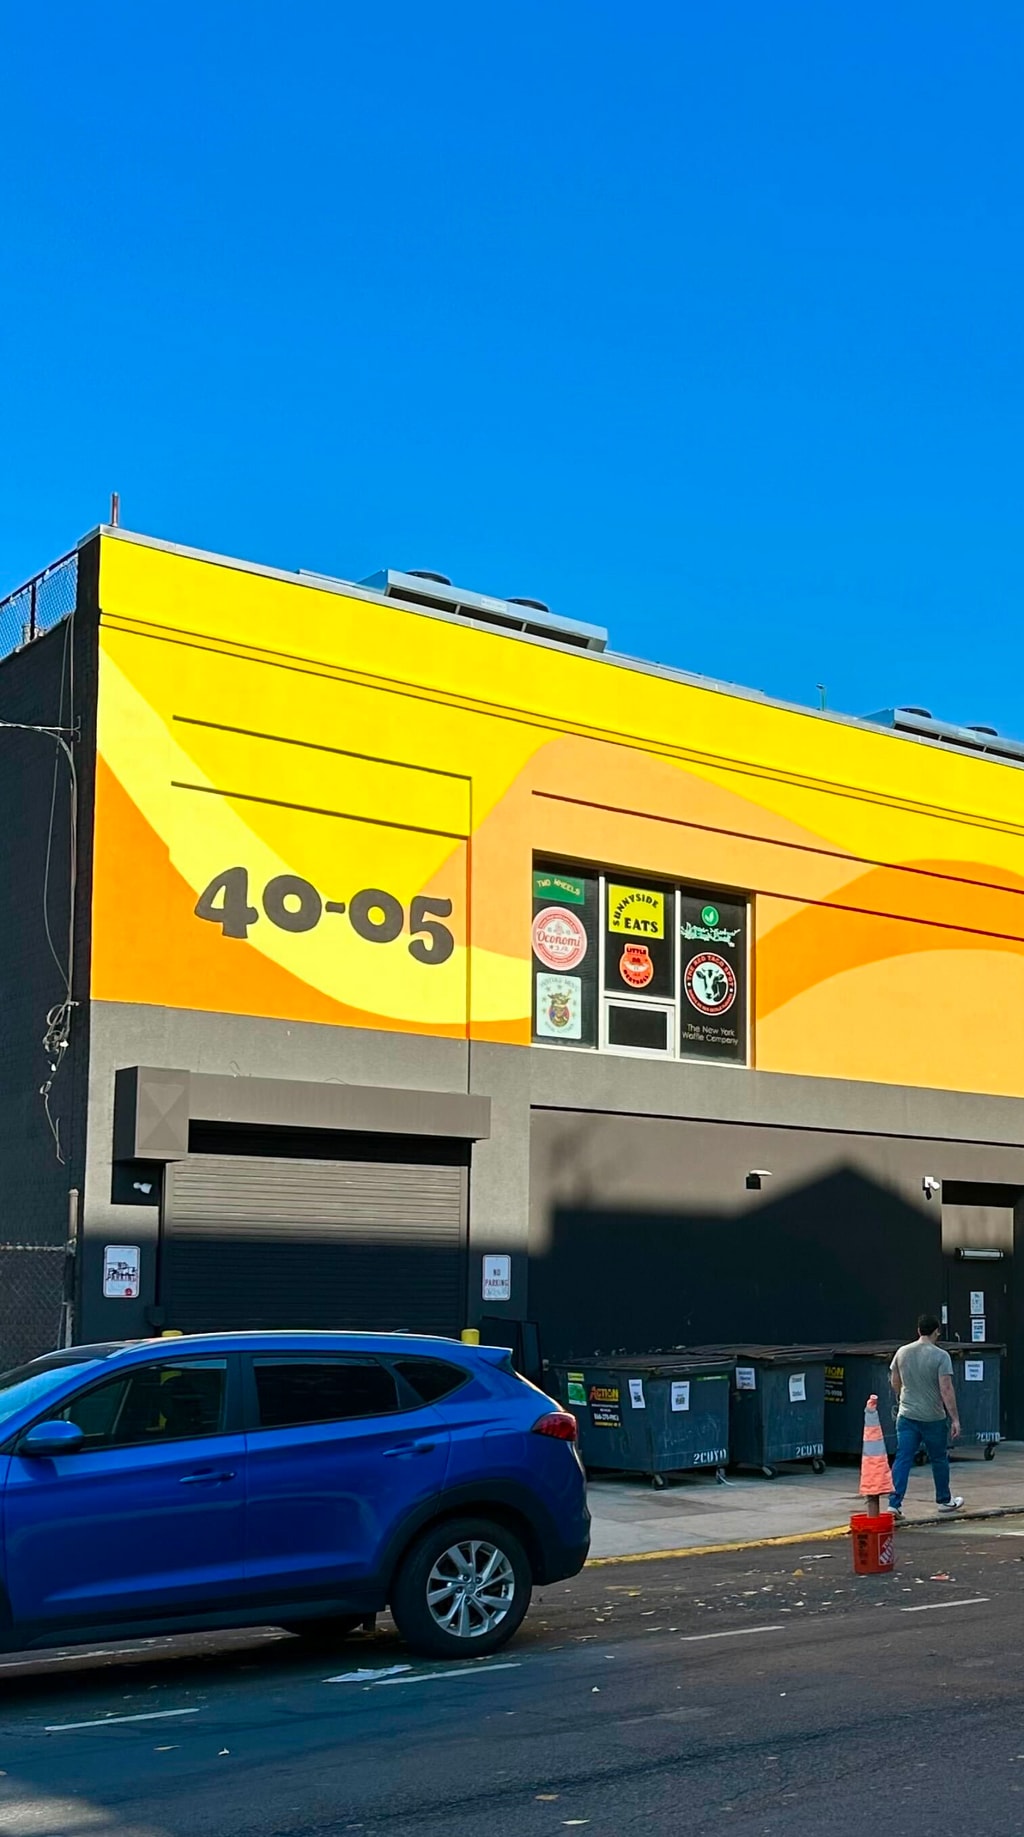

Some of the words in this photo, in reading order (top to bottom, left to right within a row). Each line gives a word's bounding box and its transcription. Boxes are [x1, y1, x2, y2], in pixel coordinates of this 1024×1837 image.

[194, 867, 454, 965] 40-05
[613, 893, 659, 927] SUNNYSIDE
[624, 917, 659, 933] EATS
[537, 930, 580, 947] Oconomi
[626, 947, 647, 955] LITTLE
[707, 955, 724, 967] TACO
[687, 1024, 700, 1032] The
[702, 1026, 719, 1034] New
[720, 1028, 735, 1036] York
[682, 1032, 705, 1041] Waffle
[706, 1034, 738, 1045] Company
[824, 1366, 844, 1376] TION
